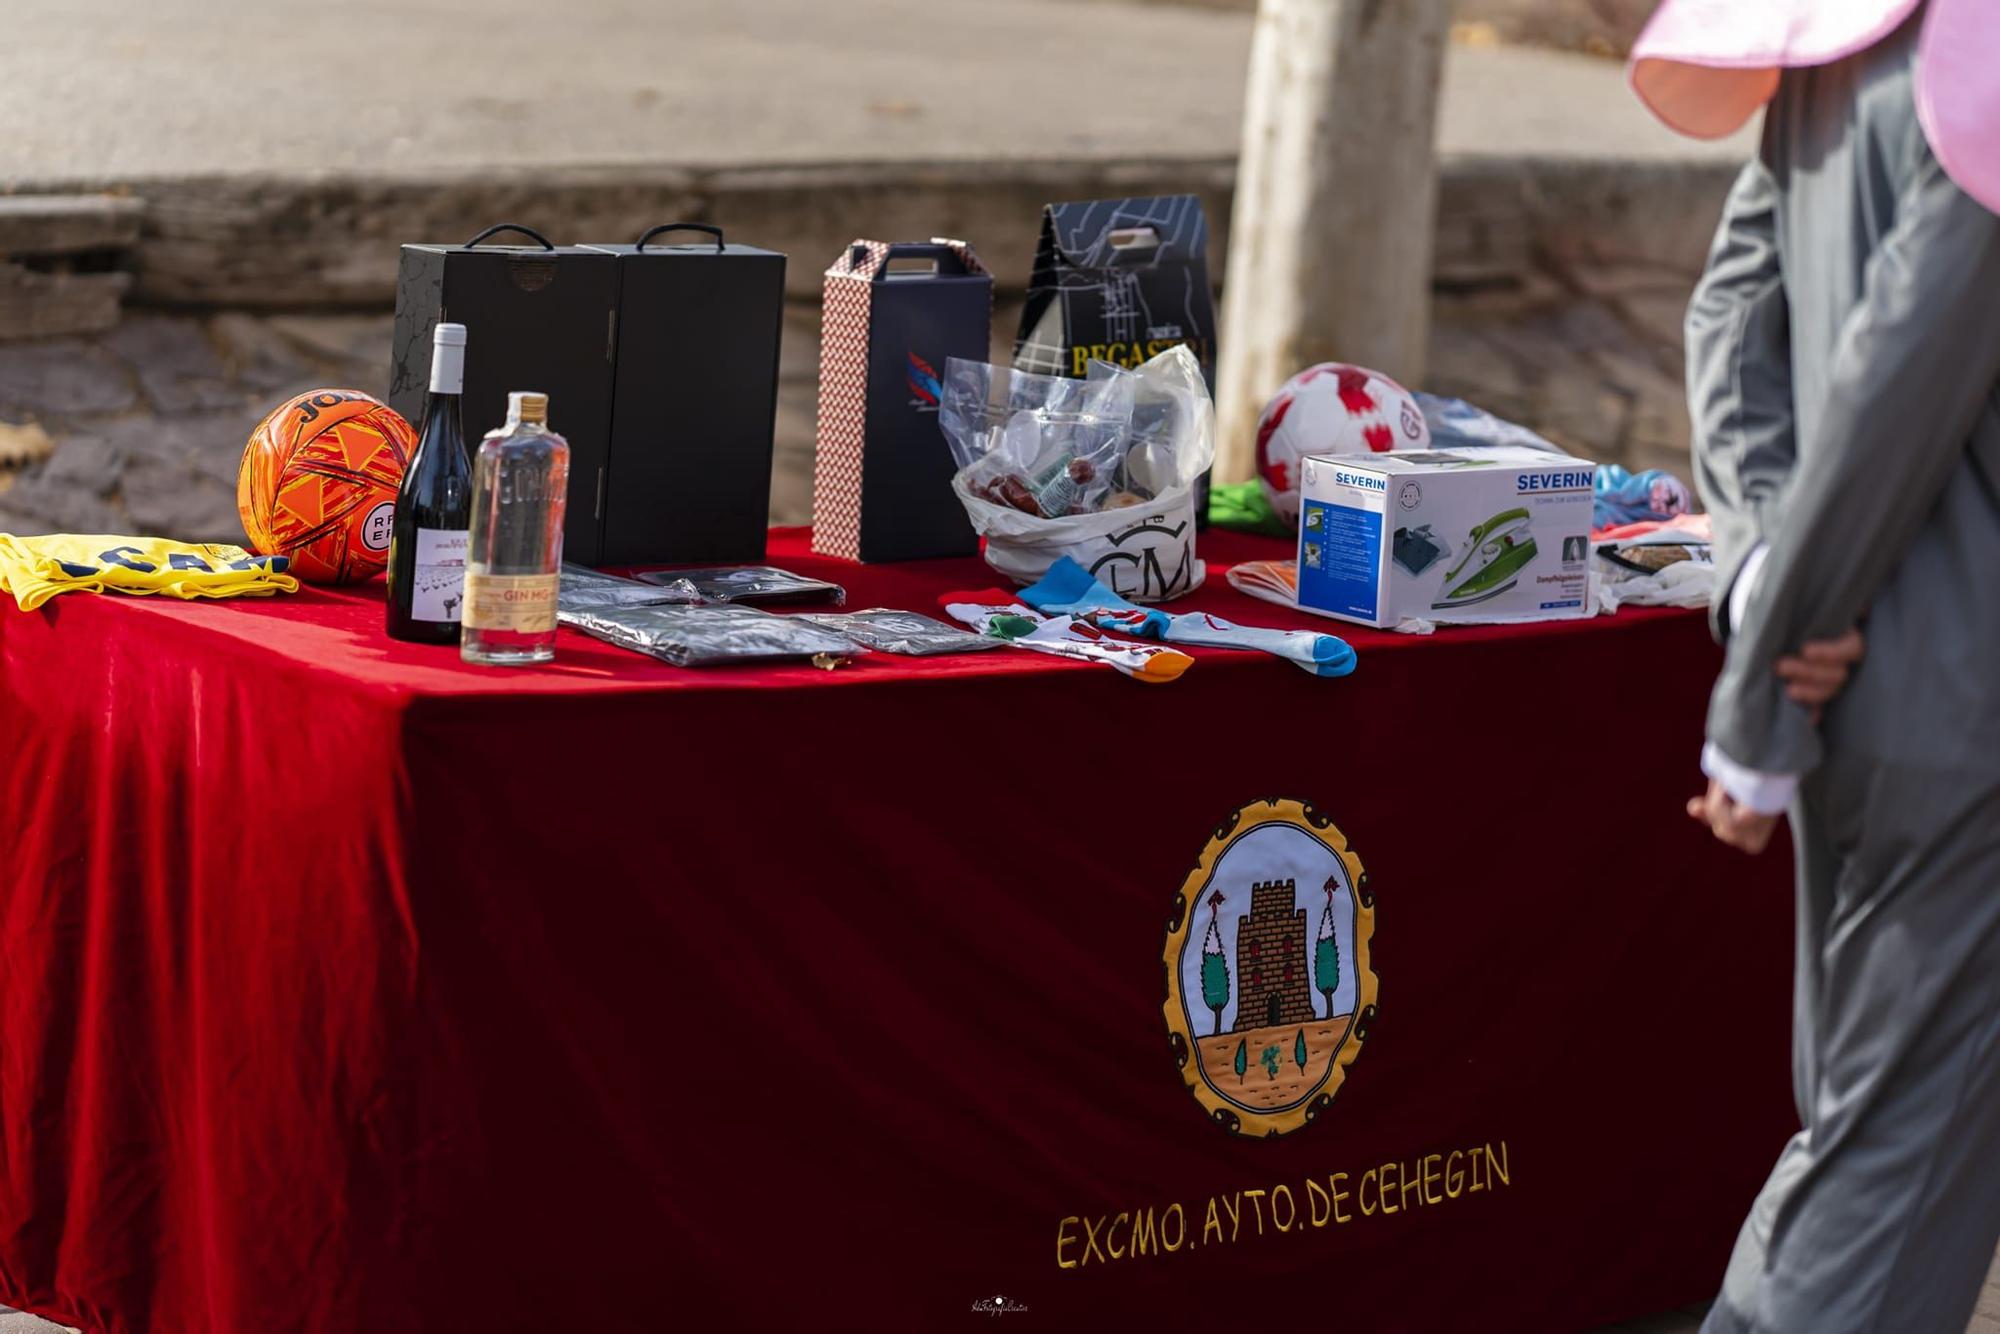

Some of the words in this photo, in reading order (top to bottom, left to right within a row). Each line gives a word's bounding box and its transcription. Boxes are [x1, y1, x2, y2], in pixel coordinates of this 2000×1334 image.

[1335, 472, 1385, 490] SEVERIN
[1517, 471, 1592, 490] SEVERIN
[504, 589, 528, 601] GIN
[1056, 1202, 1196, 1269] EXCMO.
[1203, 1184, 1304, 1245] AYTO.
[1306, 1172, 1352, 1227] DE
[1359, 1140, 1511, 1216] CEHEGIN
